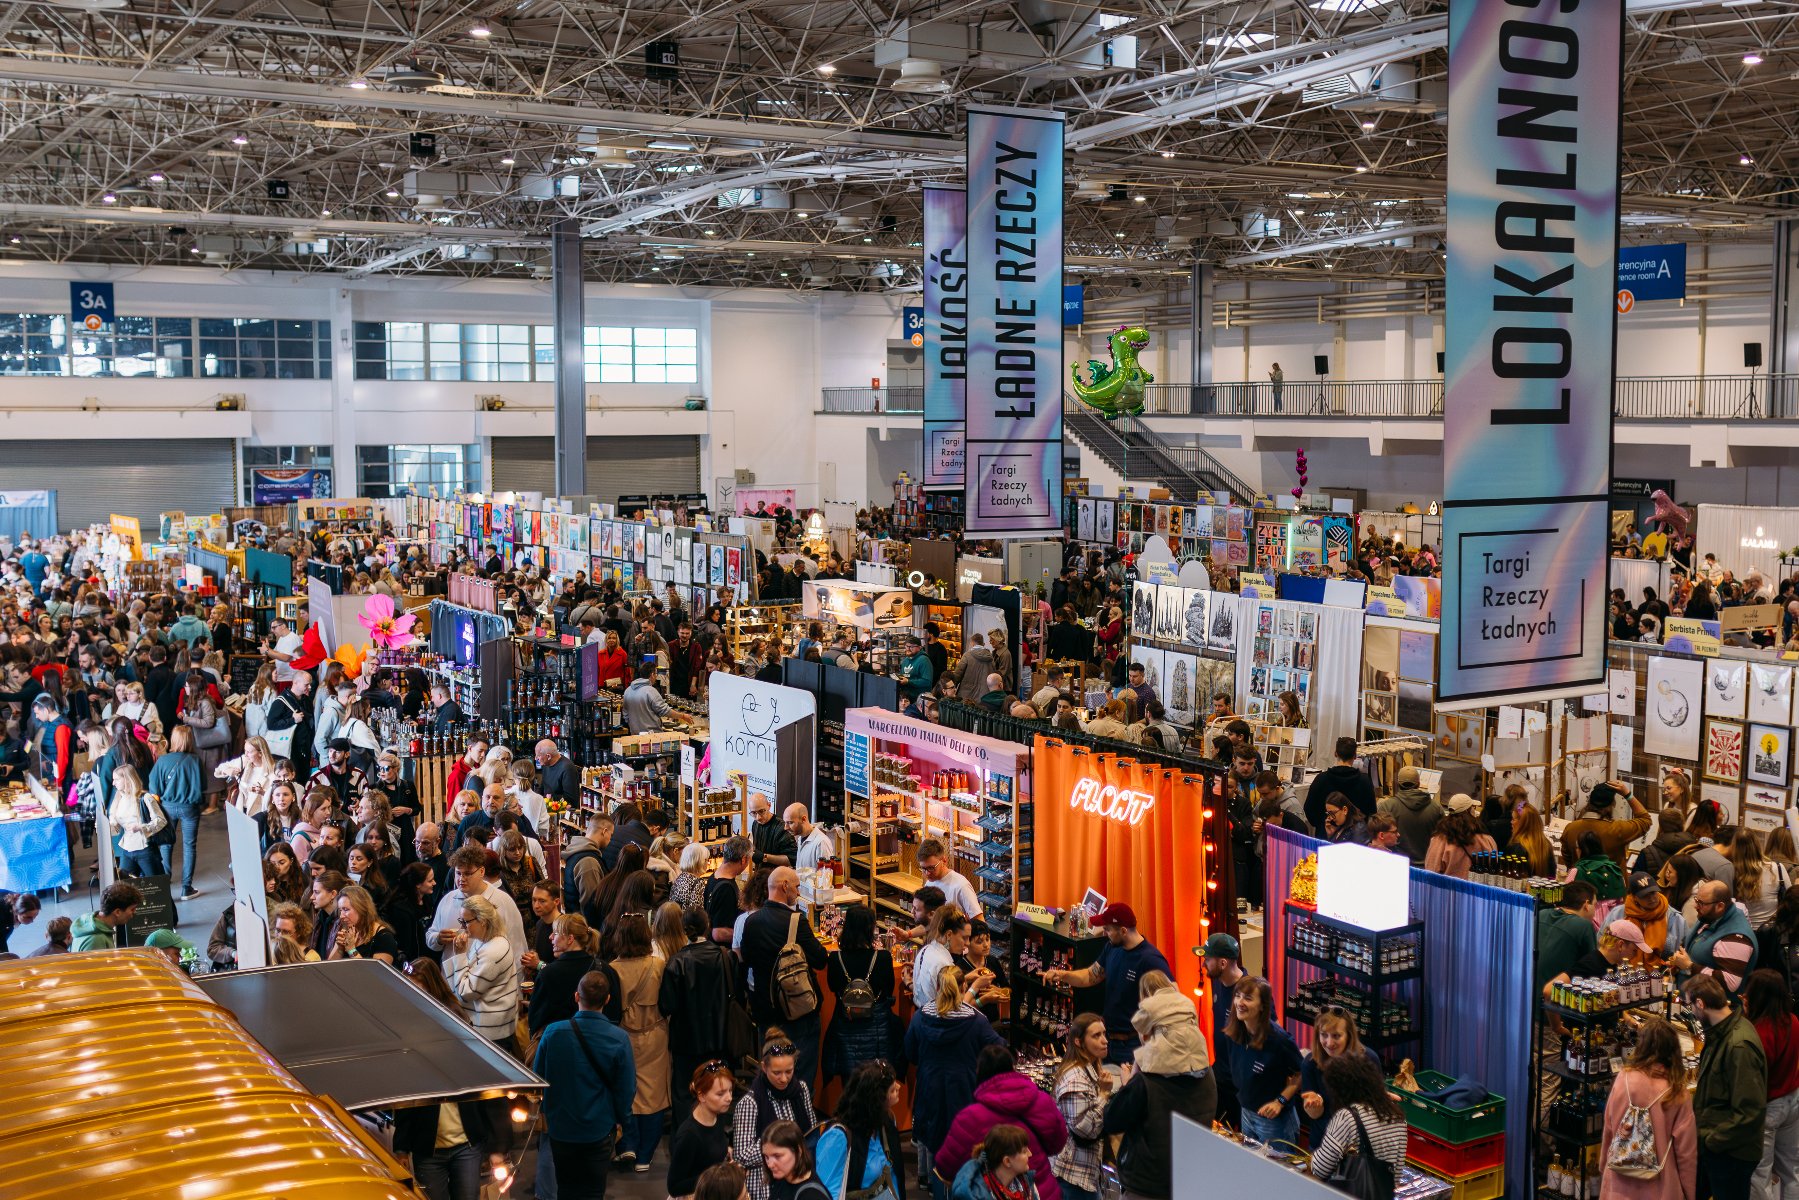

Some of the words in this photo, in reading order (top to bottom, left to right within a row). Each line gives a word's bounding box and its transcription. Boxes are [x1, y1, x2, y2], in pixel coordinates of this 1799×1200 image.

[663, 54, 675, 63] 10
[995, 141, 1038, 283] RZECZY
[1490, 0, 1580, 425] LOKALNO
[1656, 258, 1672, 279] A
[79, 289, 107, 309] 3A
[995, 297, 1036, 421] ŁADNE
[941, 437, 960, 447] Targi
[941, 448, 966, 458] Rzecz
[991, 463, 1017, 479] Targi
[991, 478, 1028, 494] Rzeczy
[1643, 482, 1651, 494] A
[990, 492, 1034, 509] Ładnych
[1482, 551, 1531, 580] Targi
[1482, 586, 1549, 610] Rzeczy
[1481, 611, 1557, 643] Ładnych
[1669, 624, 1696, 635] Serbista
[1696, 627, 1717, 637] Prints
[867, 718, 917, 738] MARCELLINO
[919, 727, 948, 748] ITALIAN
[949, 738, 965, 753] DELI
[966, 746, 973, 756] &
[974, 746, 989, 761] CO.
[1637, 877, 1650, 887] W
[1025, 905, 1040, 915] FLOAT
